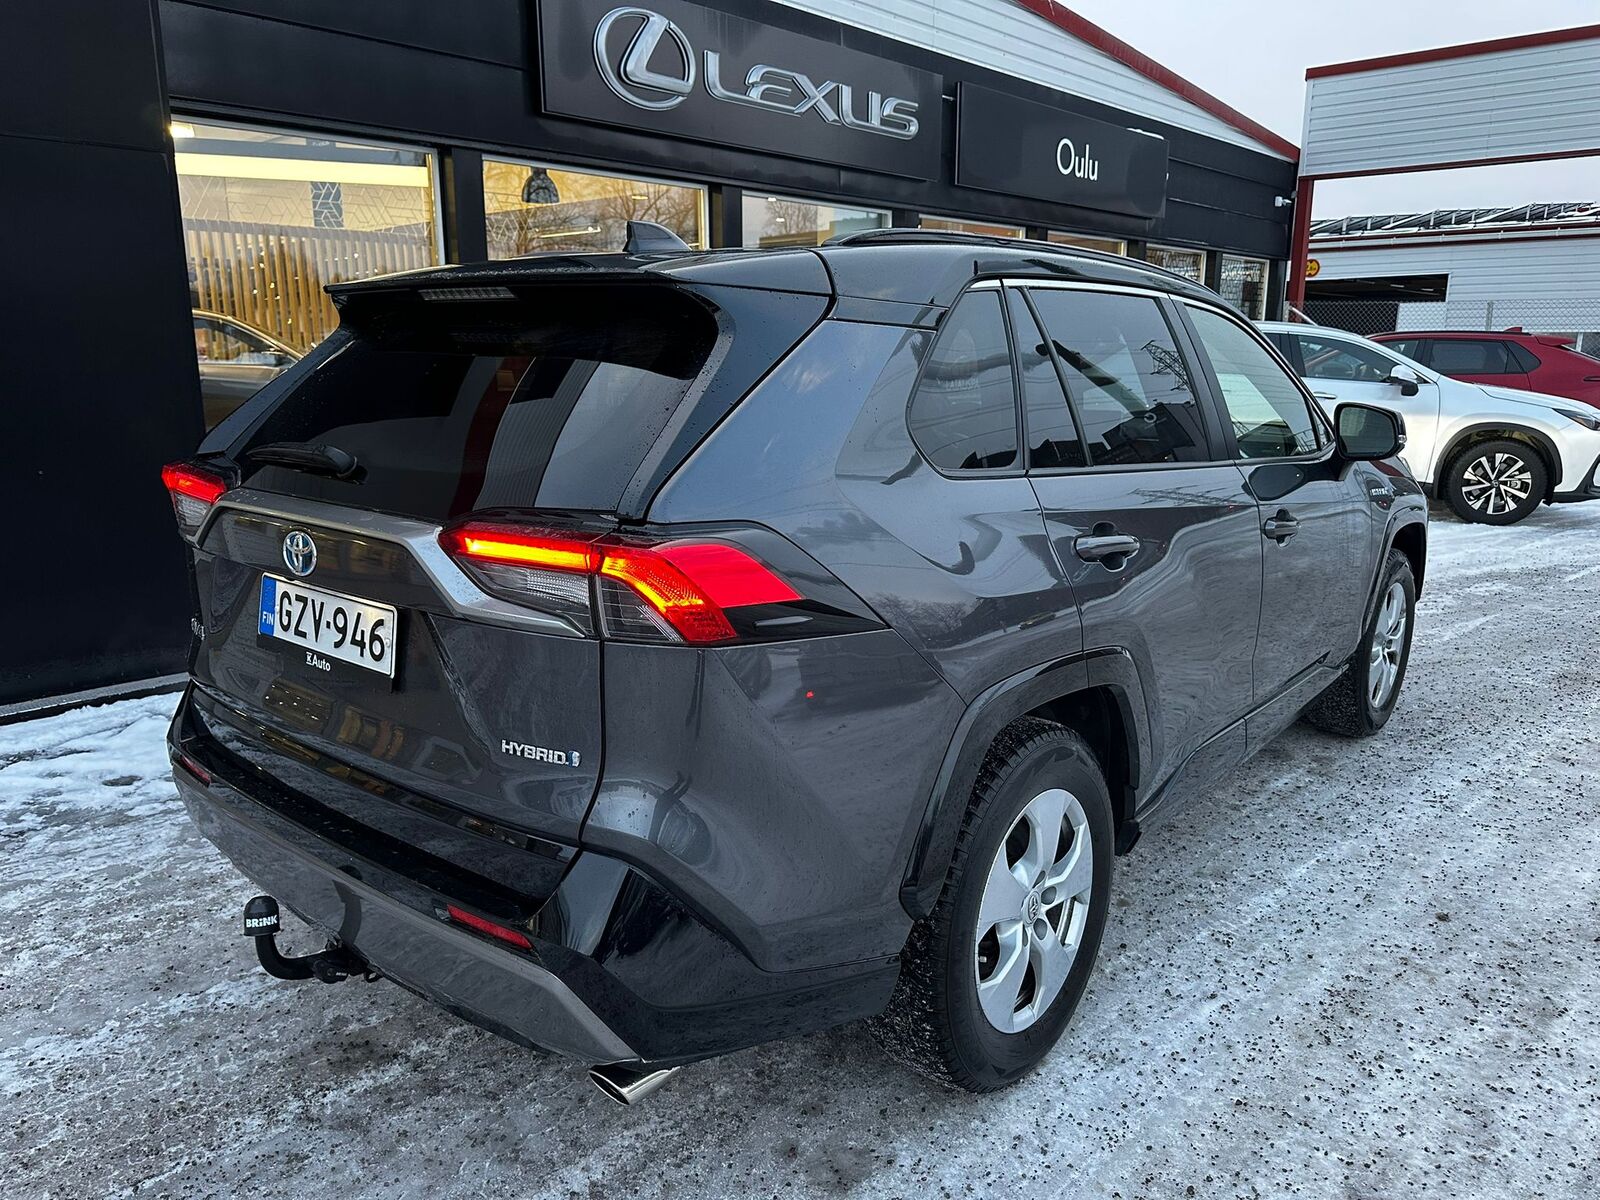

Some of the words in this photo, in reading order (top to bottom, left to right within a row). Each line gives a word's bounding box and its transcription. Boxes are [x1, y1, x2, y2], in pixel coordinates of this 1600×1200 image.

[703, 49, 919, 141] LEXUS
[1056, 138, 1099, 181] Oulu
[262, 611, 274, 626] FIN
[279, 590, 385, 662] GZV-946
[501, 739, 566, 765] HYBRID
